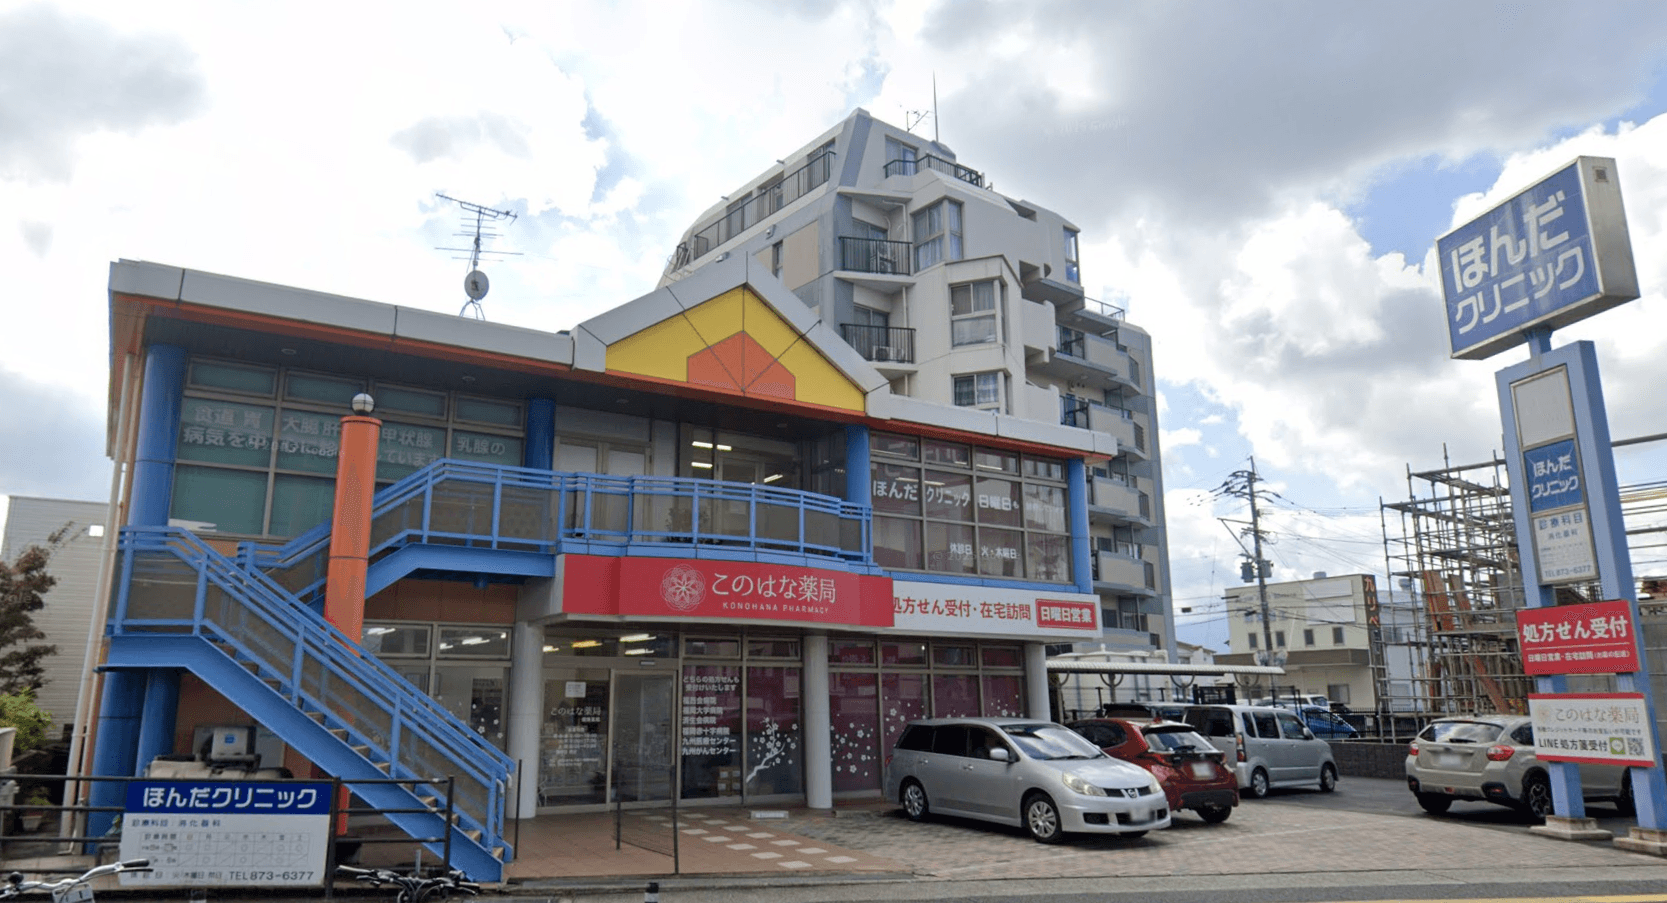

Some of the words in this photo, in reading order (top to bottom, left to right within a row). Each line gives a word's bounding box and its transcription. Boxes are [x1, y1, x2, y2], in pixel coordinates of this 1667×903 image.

[1451, 189, 1570, 294] ほんだ
[1454, 247, 1585, 335] クリニック
[1531, 453, 1573, 479] ほんだ
[872, 479, 918, 502] ほんだ
[925, 487, 970, 509] クリニック
[1531, 475, 1579, 501] クリニック
[711, 573, 836, 603] このはな薬局
[722, 602, 778, 612] KONOHANA
[782, 604, 829, 614] PHARMACY
[1040, 606, 1092, 623] 日曜日営業
[1524, 616, 1628, 642] 処方せん受付
[685, 684, 737, 692] 受付けいたします
[550, 706, 602, 716] このはな薬局
[1555, 706, 1639, 724] このはな薬局
[682, 737, 737, 746] 九州医療センター
[682, 747, 737, 756] 九州がんセンター
[1538, 738, 1559, 749] LINE
[142, 786, 318, 809] ほんだクリニック
